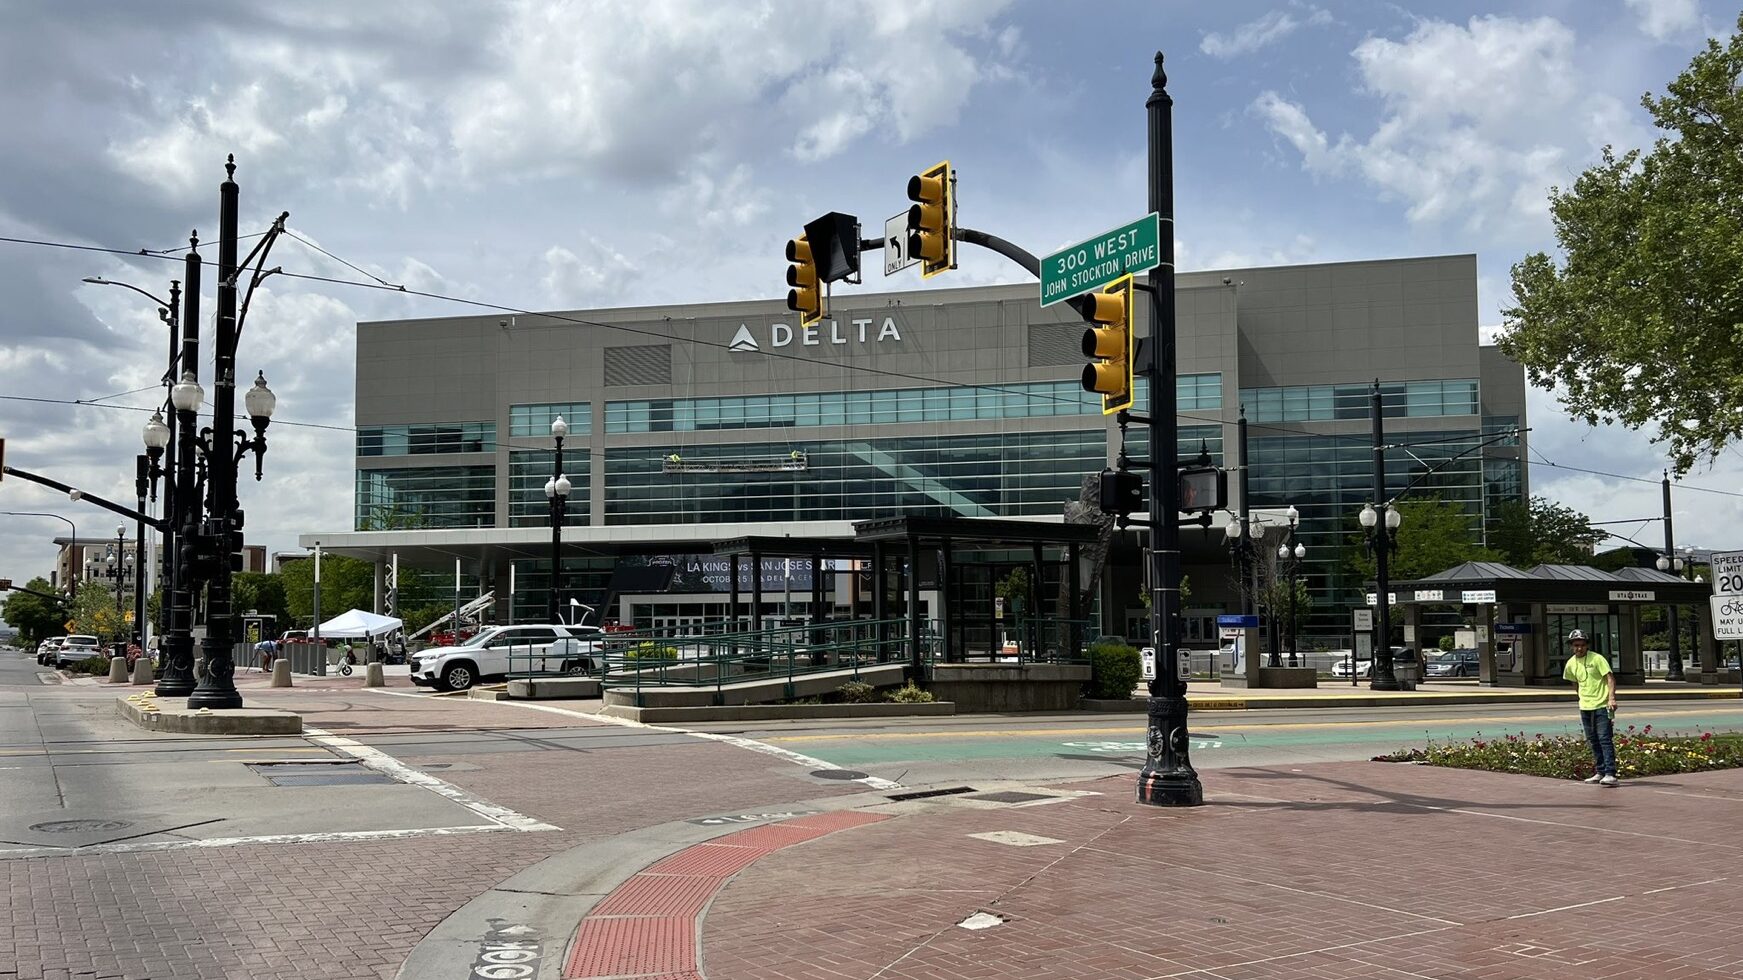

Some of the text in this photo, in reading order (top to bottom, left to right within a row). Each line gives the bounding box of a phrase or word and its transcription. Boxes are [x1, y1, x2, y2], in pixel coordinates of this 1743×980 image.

[1057, 228, 1138, 274] 300 WEST
[887, 260, 902, 273] ONLY
[1044, 244, 1155, 298] JOHN STOCKTON DRIVE
[771, 317, 901, 347] DELTA
[687, 562, 700, 572] LA
[1718, 565, 1741, 573] LIMIT
[1719, 575, 1743, 592] 20
